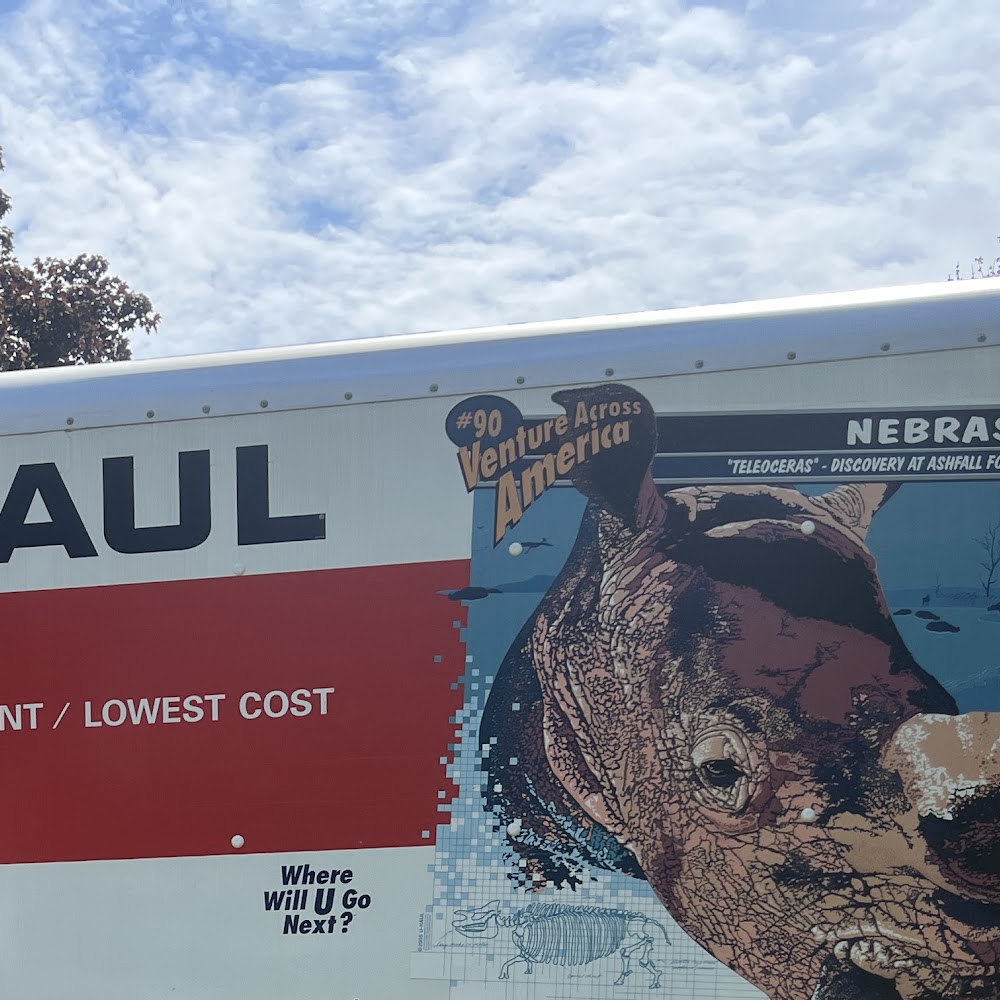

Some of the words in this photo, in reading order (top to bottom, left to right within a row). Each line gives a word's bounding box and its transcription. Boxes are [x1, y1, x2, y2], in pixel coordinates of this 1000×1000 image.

[456, 409, 502, 438] #90
[457, 414, 569, 493] Venture
[574, 401, 642, 428] Across
[727, 457, 819, 474] "TELEOCERAS"
[830, 457, 906, 473] DISCOVERY
[907, 457, 925, 471] AT
[927, 455, 982, 471] ASHFALL
[493, 420, 631, 549] America
[52, 702, 70, 730] /
[84, 693, 226, 728] LOWEST
[239, 687, 335, 719] COST
[281, 864, 353, 885] Where
[264, 889, 308, 911] Will
[314, 888, 335, 915] U
[342, 889, 371, 909] Go
[283, 911, 353, 934] Next?
